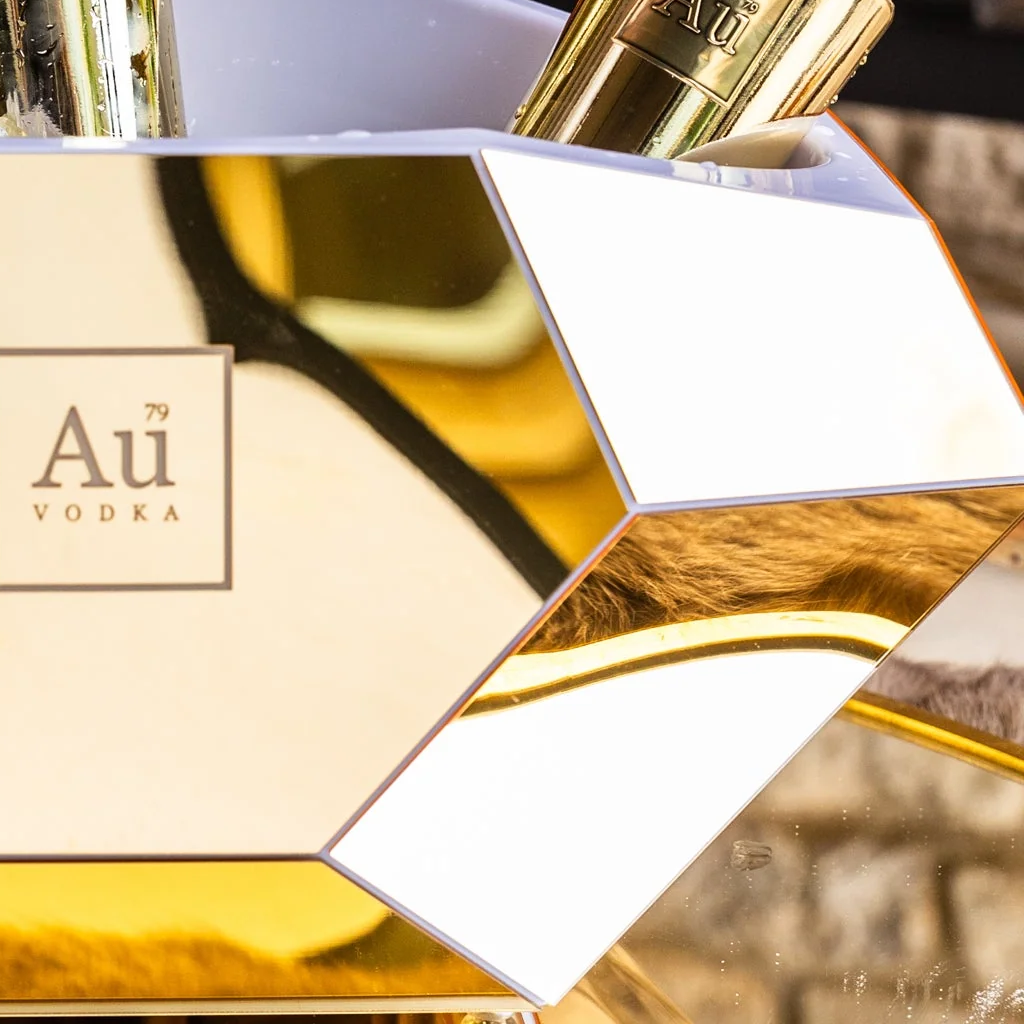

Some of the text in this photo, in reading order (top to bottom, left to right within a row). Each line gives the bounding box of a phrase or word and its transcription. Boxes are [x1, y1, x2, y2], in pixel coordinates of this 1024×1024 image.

[144, 403, 170, 421] 79
[31, 404, 176, 489] Au
[33, 503, 180, 522] VODKA
